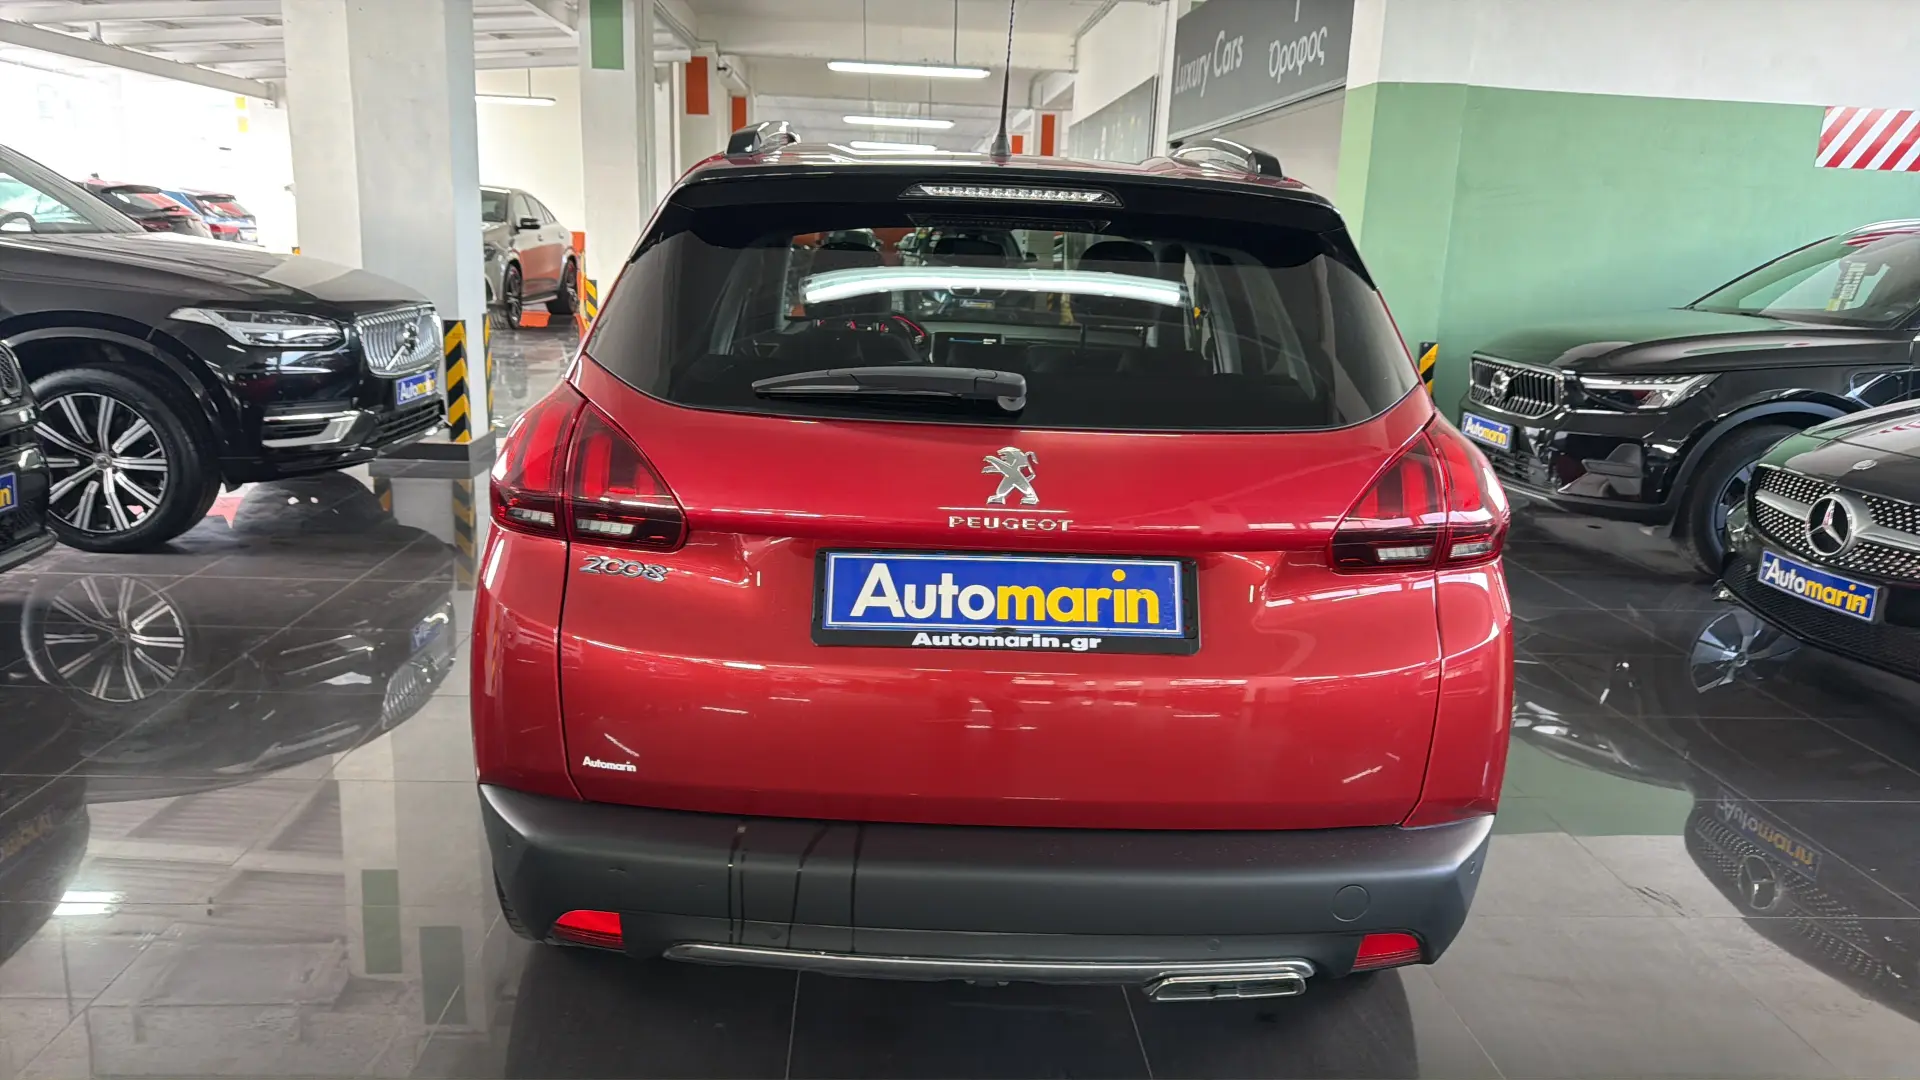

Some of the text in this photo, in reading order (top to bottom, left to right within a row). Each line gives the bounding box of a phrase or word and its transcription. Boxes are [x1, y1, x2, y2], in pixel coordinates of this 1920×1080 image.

[1175, 30, 1244, 98] Luxury Cars
[948, 515, 1074, 532] PEUGEOT
[579, 556, 669, 583] 2008
[850, 562, 1160, 625] Automarin
[1764, 558, 1869, 615] Automarin
[911, 632, 1102, 652] Automarin.gr
[582, 755, 638, 773] Automarin
